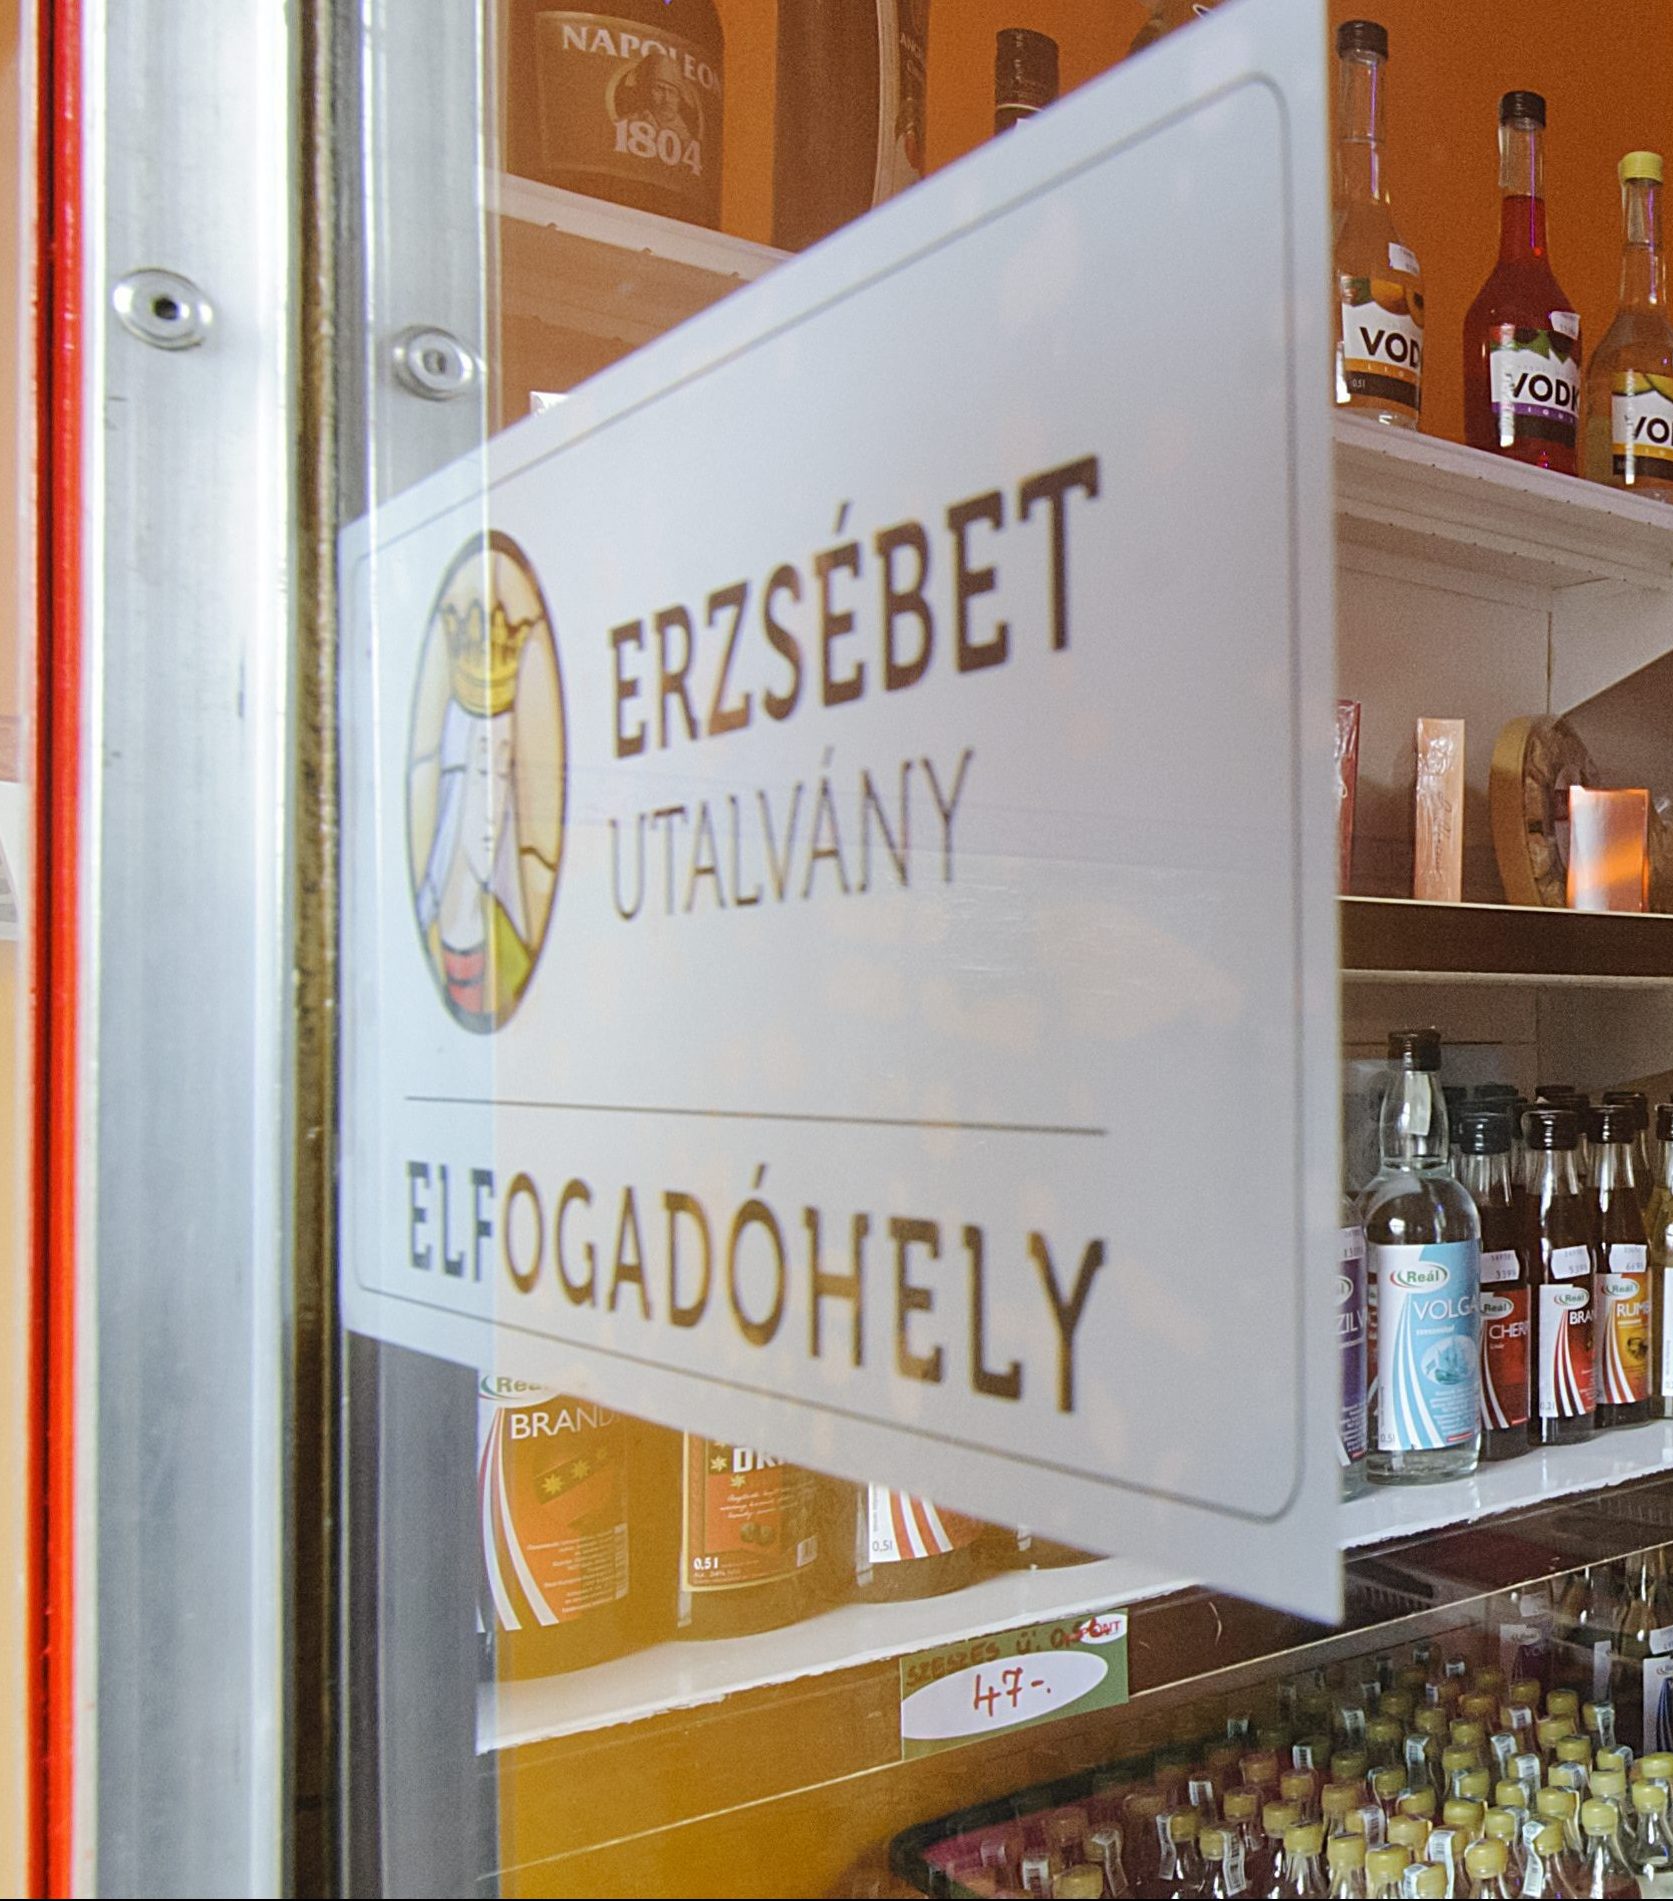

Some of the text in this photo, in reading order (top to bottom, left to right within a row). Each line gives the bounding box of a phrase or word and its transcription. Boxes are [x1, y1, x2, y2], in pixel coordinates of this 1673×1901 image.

[612, 118, 703, 177] 1804
[608, 453, 1100, 758] ERZSÉBET
[608, 745, 975, 921] UTALVÁNY
[407, 1160, 1108, 1414] ELFOGADÓHELY
